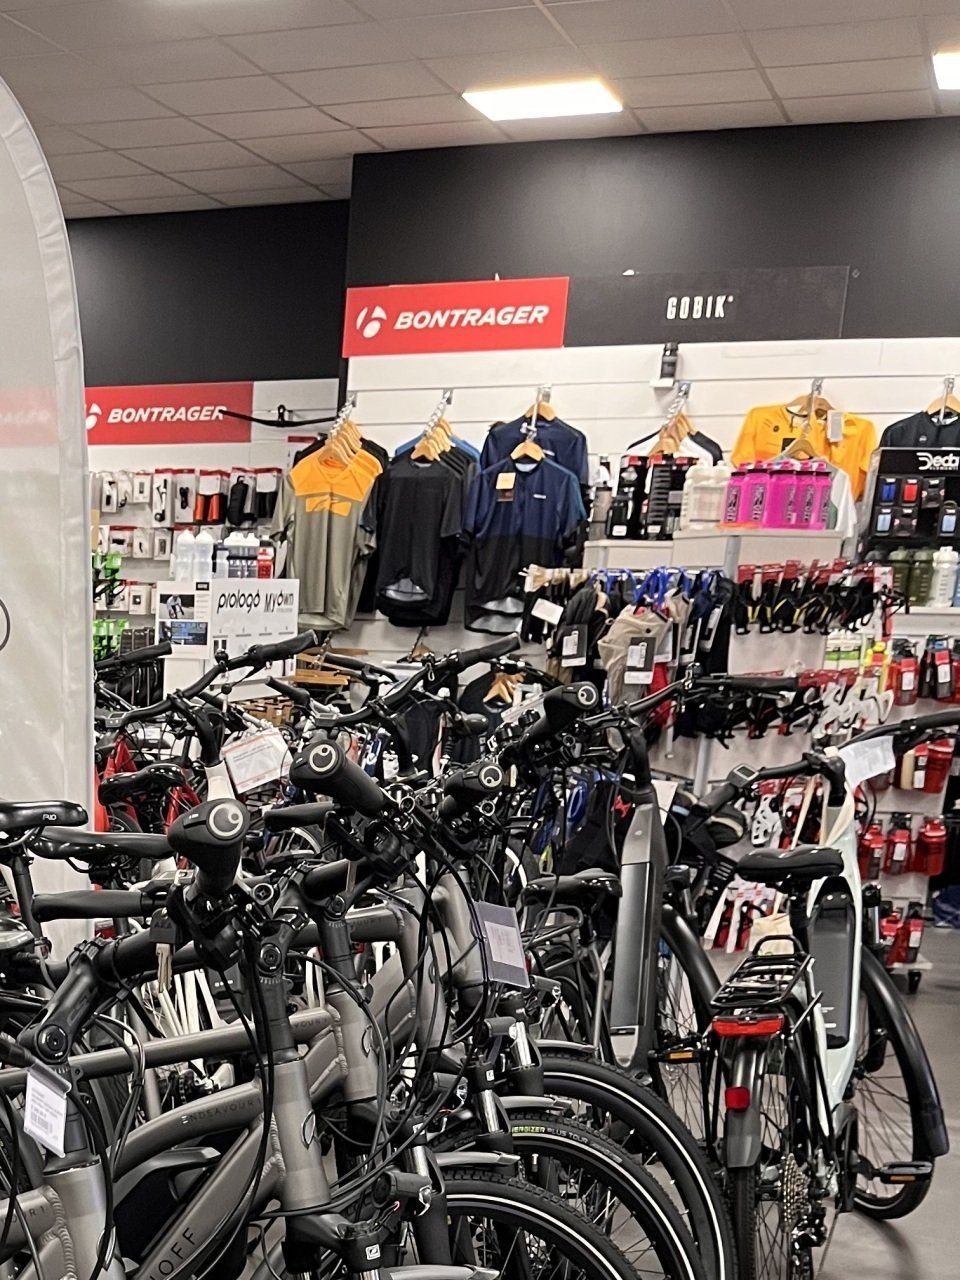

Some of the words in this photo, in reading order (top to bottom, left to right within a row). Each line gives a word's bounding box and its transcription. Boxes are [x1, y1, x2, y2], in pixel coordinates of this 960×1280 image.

[393, 304, 550, 331] BONTRAGER
[666, 295, 727, 320] GOBIK
[107, 405, 228, 424] BONTRAGER
[217, 589, 261, 614] prologo
